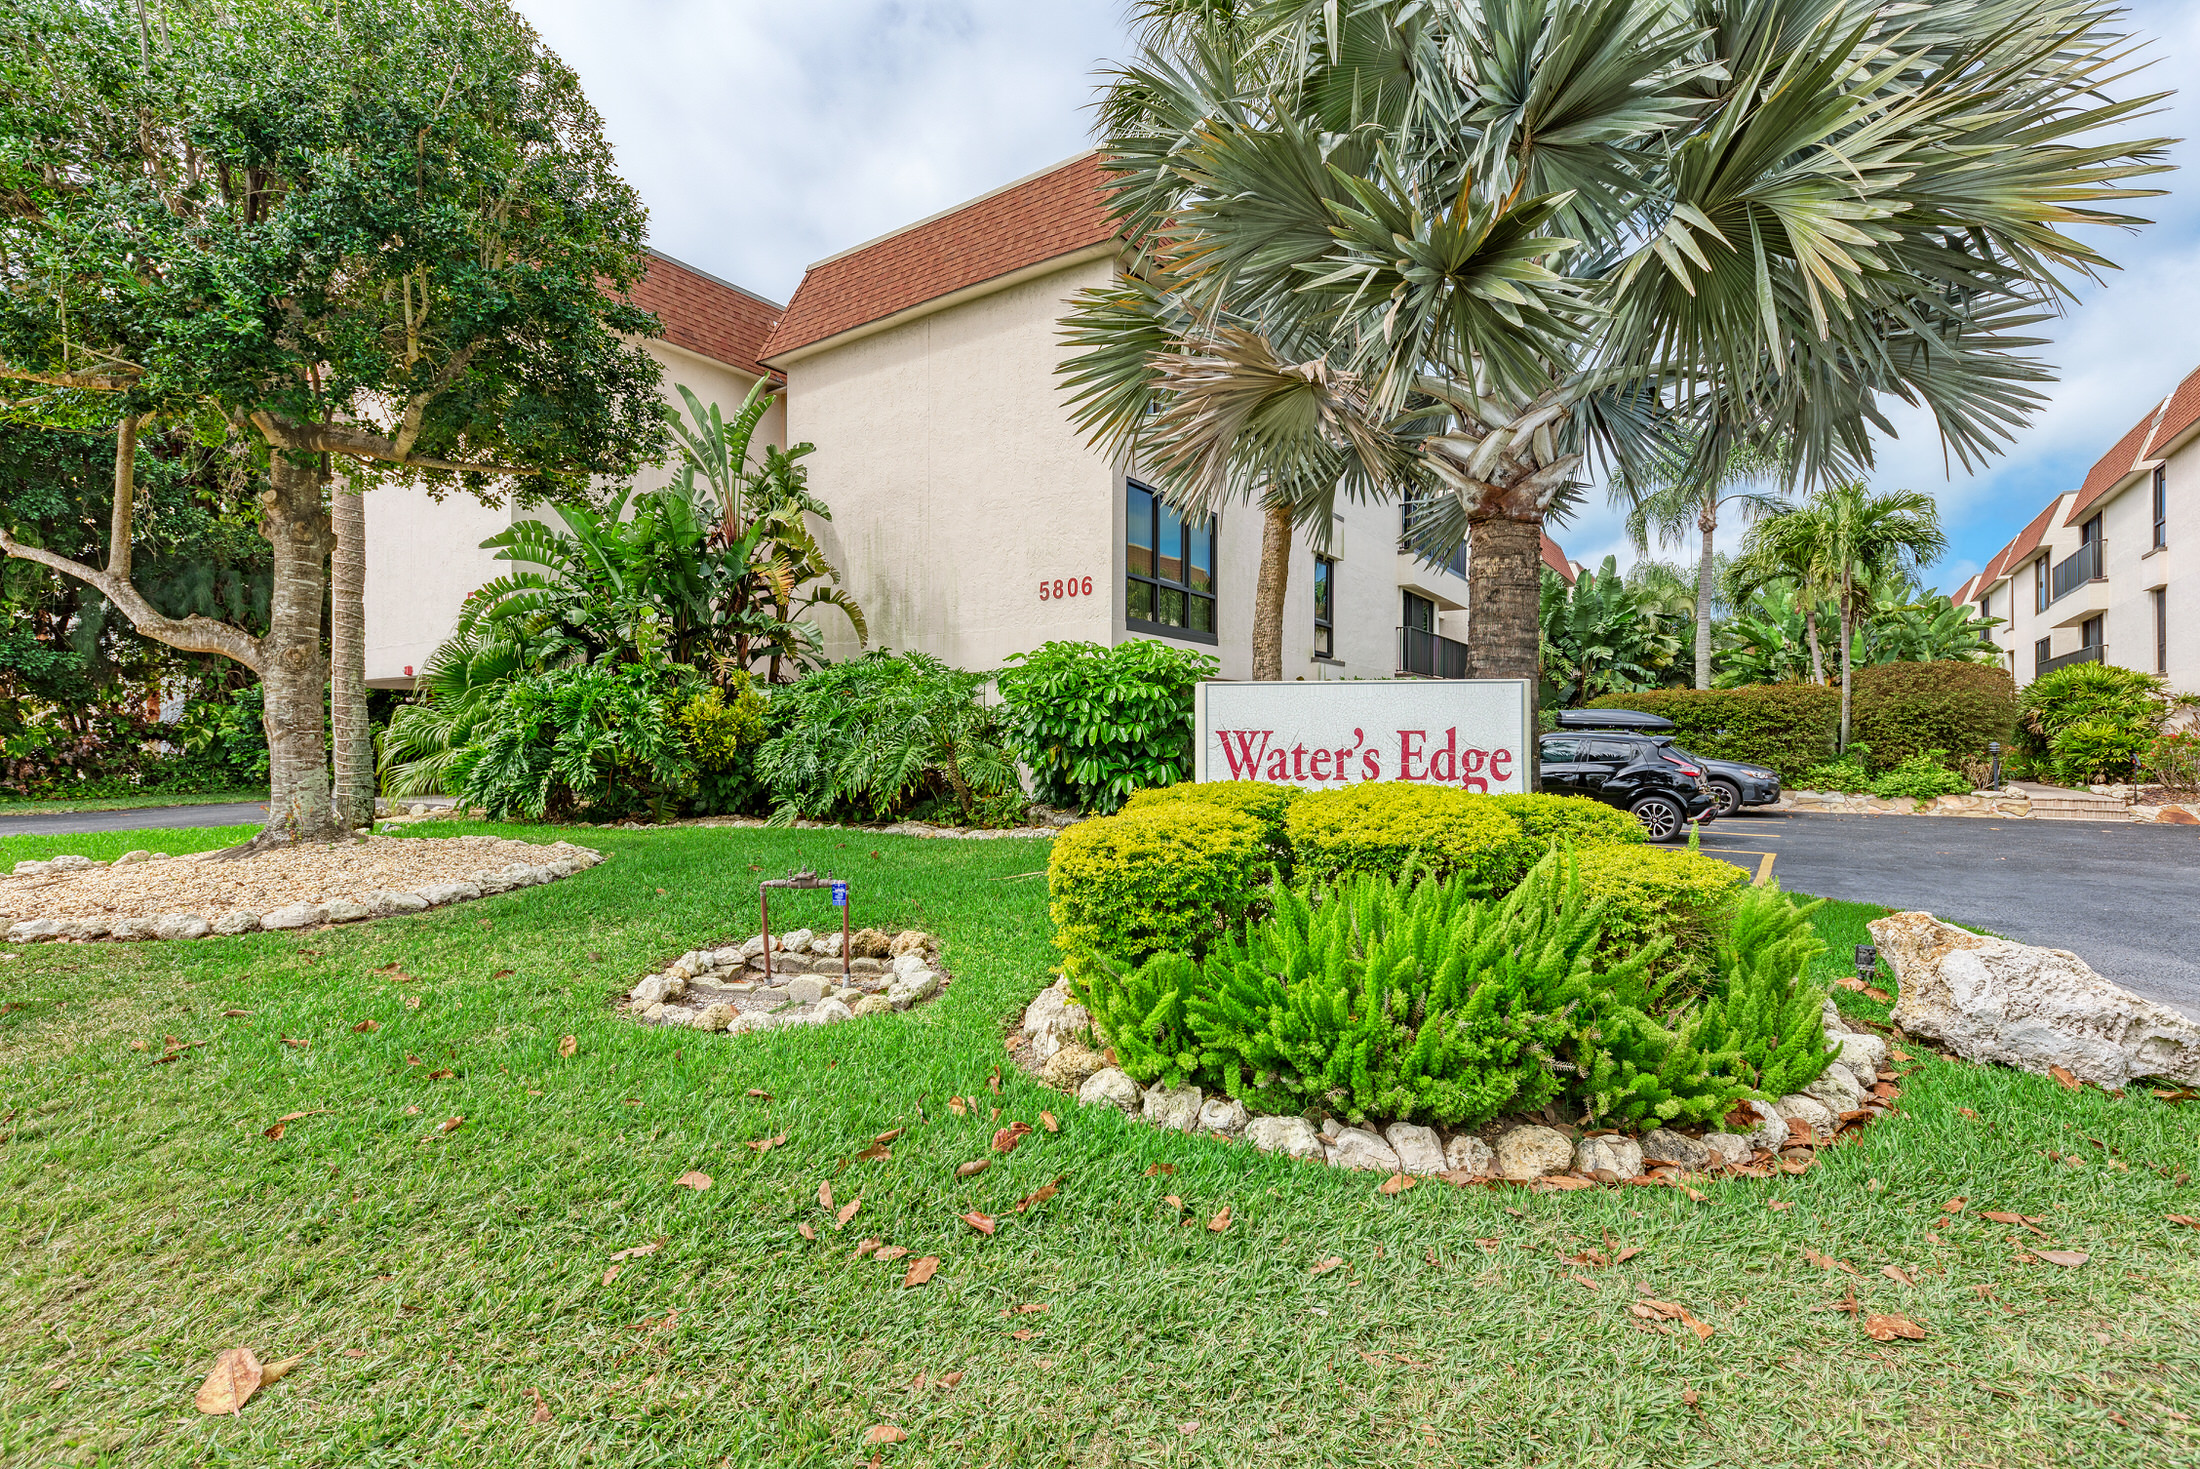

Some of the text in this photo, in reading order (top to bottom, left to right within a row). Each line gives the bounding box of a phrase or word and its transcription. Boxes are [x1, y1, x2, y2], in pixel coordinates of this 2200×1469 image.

[1039, 575, 1093, 601] 5806
[1215, 726, 1512, 794] Water's Edge
